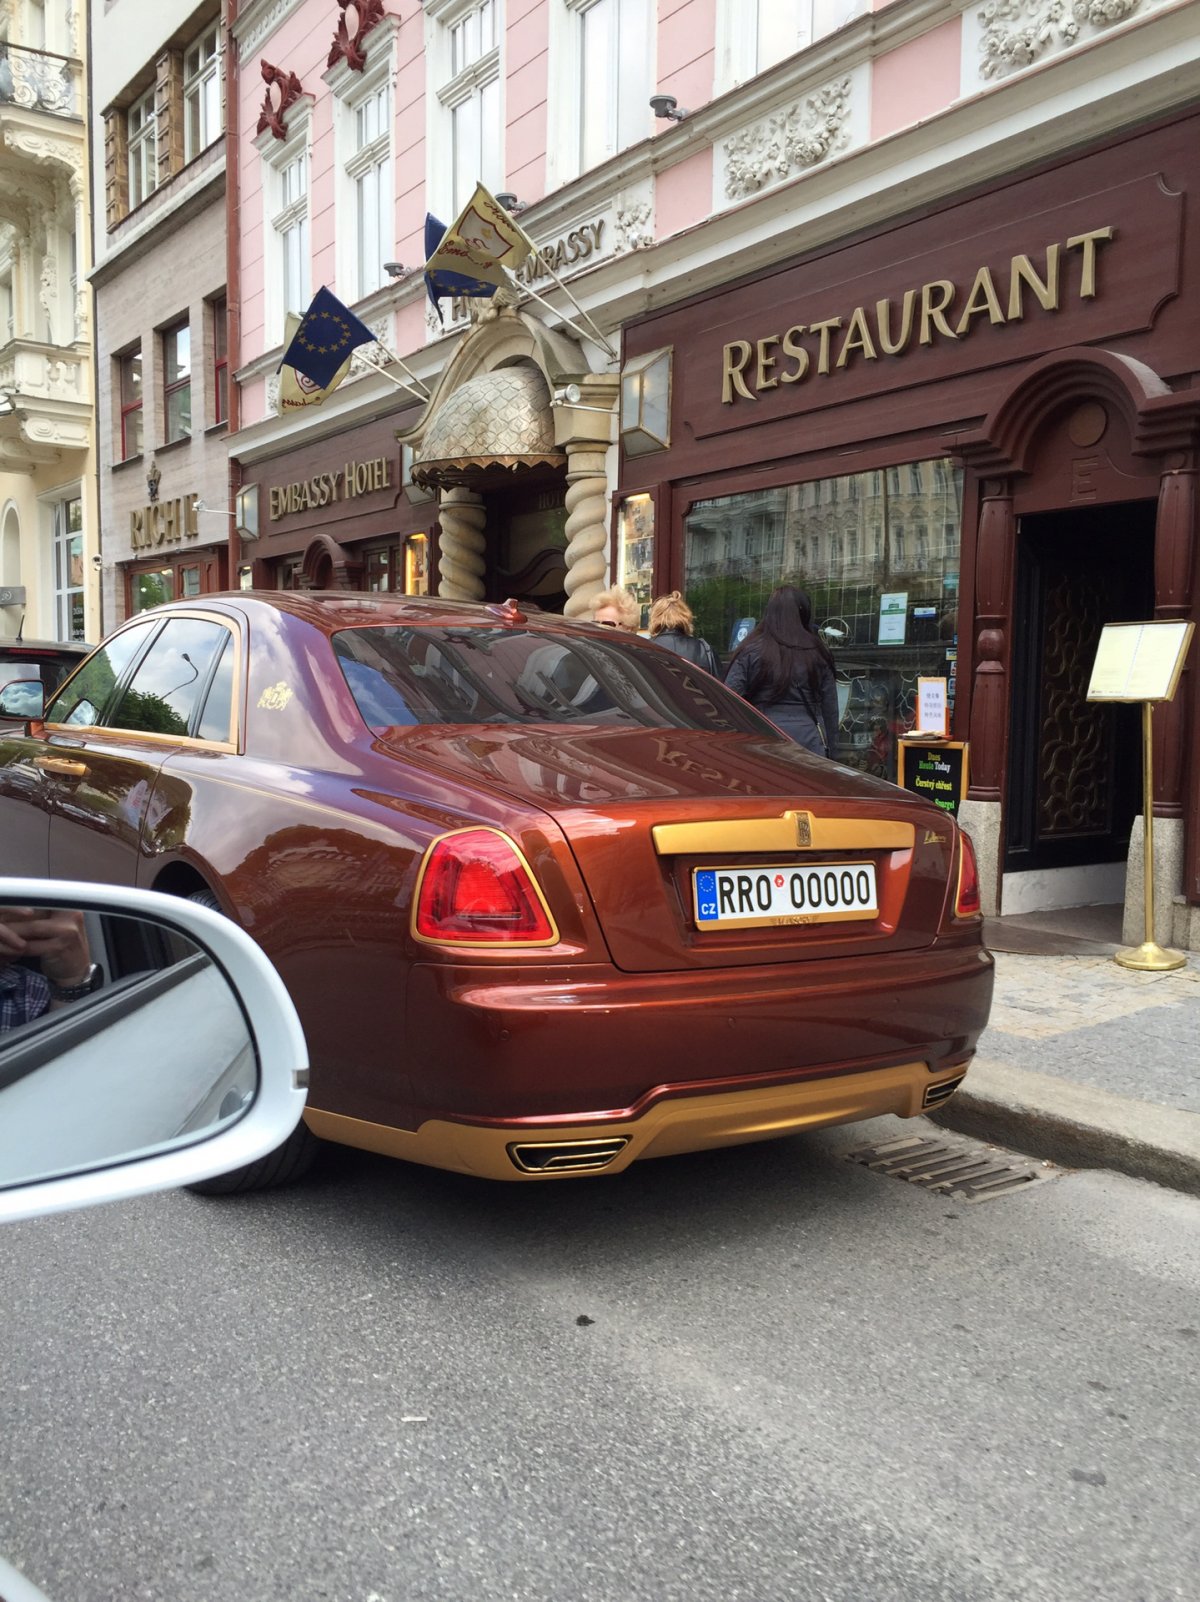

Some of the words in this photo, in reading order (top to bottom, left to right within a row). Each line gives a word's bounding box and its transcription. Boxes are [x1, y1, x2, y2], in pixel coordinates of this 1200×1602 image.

[515, 218, 606, 293] EMBASSY
[720, 225, 1115, 405] RESTAURANT
[269, 471, 342, 521] EMBASSY
[344, 456, 391, 499] HOTEL
[934, 761, 951, 774] Today
[701, 903, 717, 916] CZ
